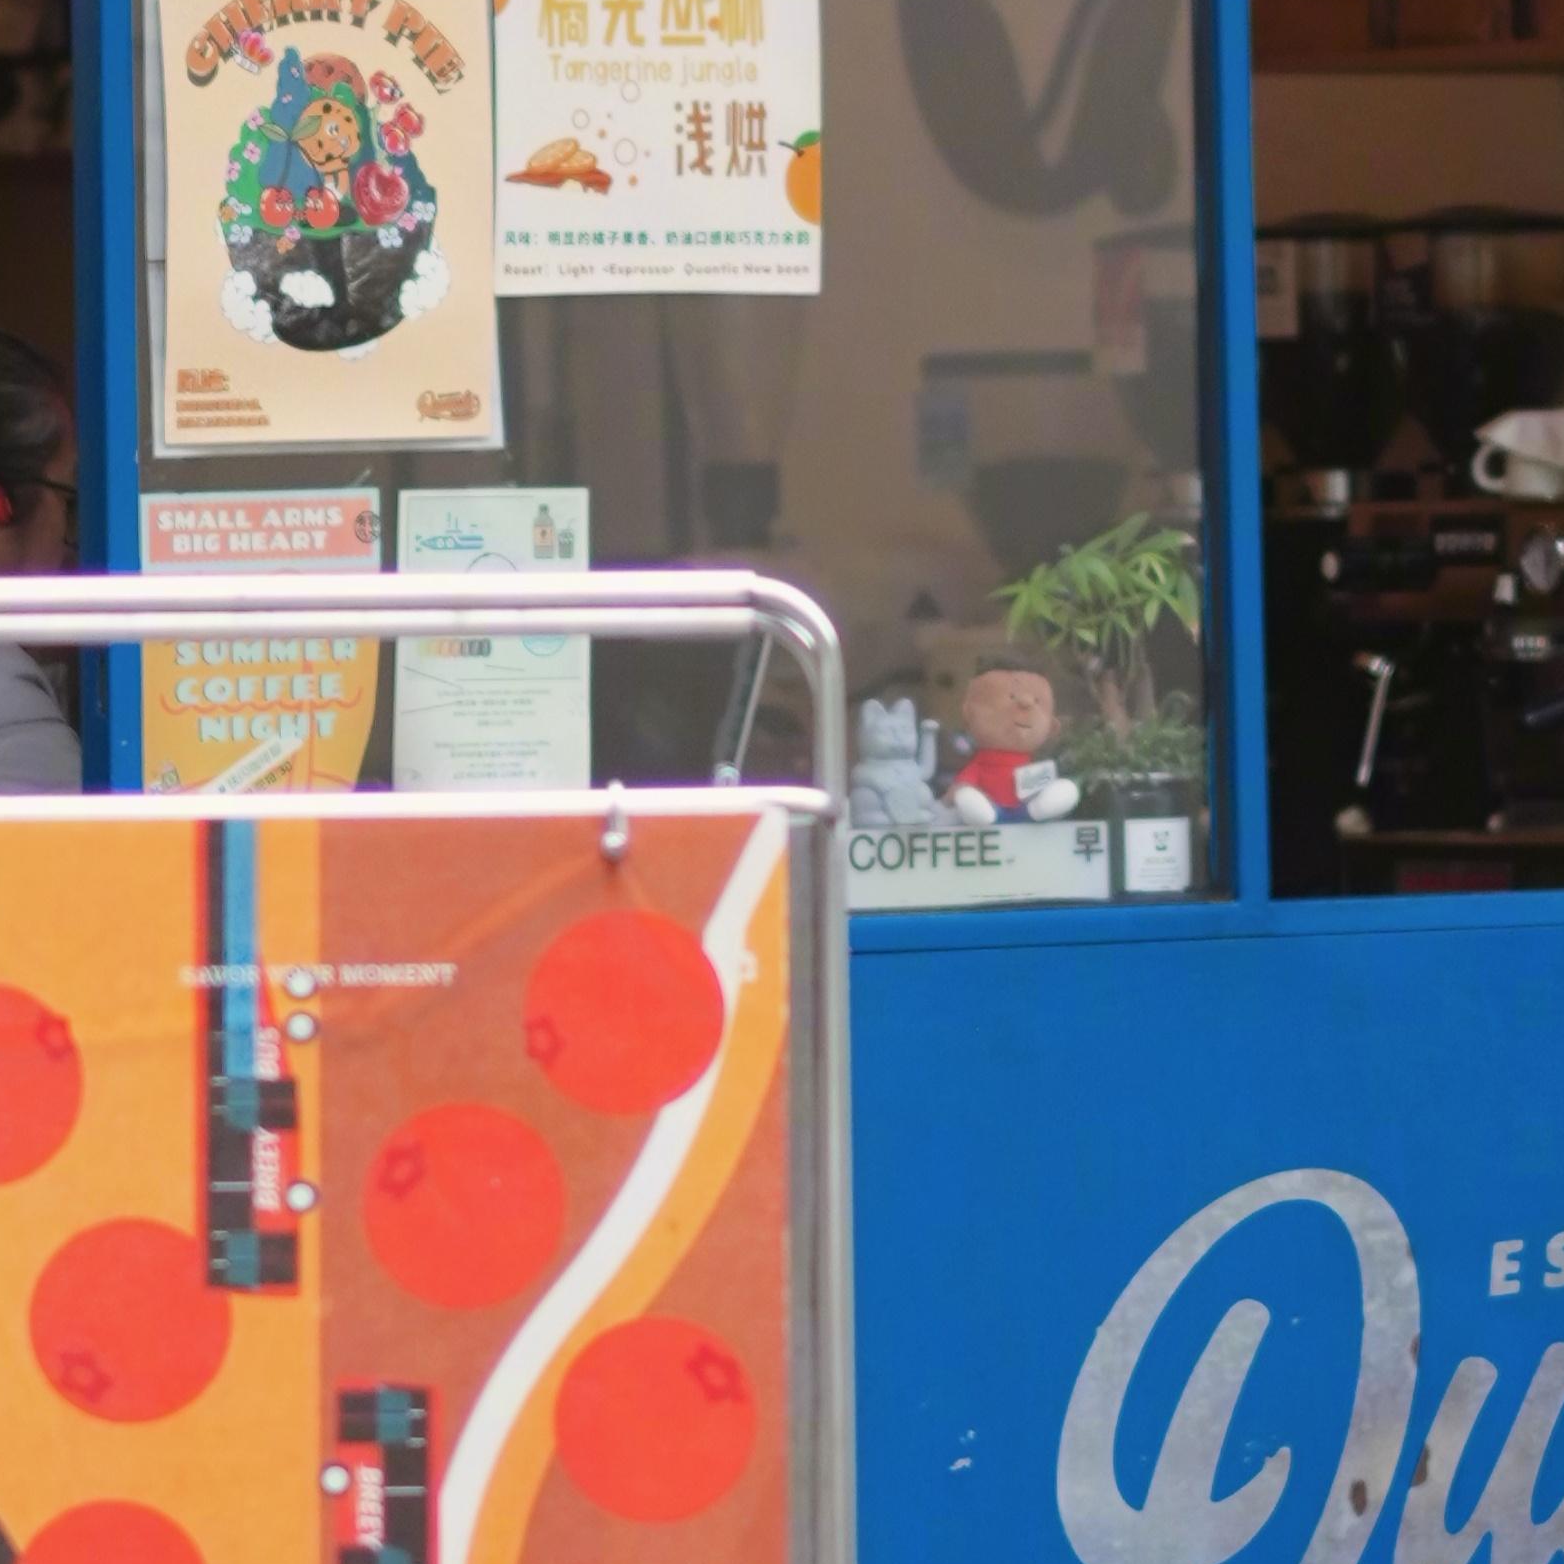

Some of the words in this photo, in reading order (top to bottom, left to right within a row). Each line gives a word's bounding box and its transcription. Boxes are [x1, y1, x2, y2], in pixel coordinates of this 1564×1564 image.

[549, 53, 673, 86] Tangerine
[680, 54, 759, 86] jungle
[674, 100, 768, 177] 浅烘
[157, 508, 253, 531] SMALL
[260, 505, 344, 528] ARMS
[172, 532, 221, 554] BIG
[228, 529, 329, 553] HEART
[175, 638, 358, 667] SUMMER
[175, 672, 345, 705] COFFEE
[198, 712, 336, 743] NIGHT
[848, 829, 1003, 871] COFFEE
[1073, 825, 1104, 863] 早
[340, 962, 458, 987] MOMENT
